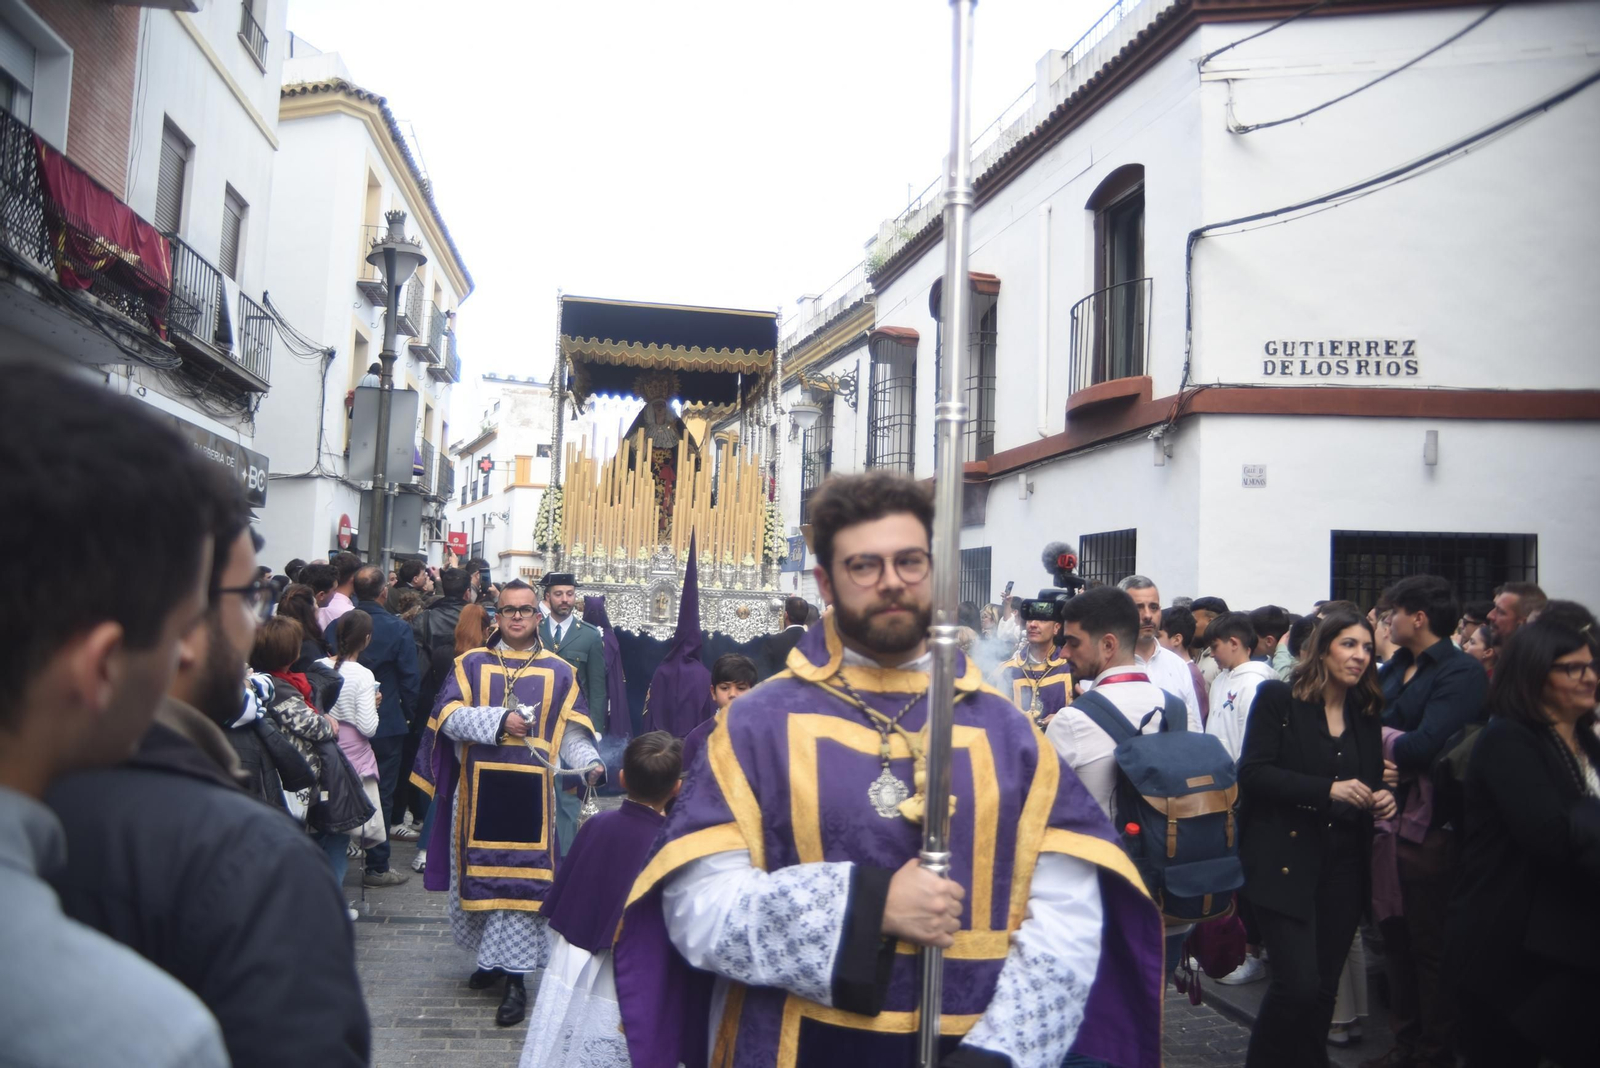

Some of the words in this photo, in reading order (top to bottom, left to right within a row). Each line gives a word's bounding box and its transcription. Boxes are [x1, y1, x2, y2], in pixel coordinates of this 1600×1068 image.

[1264, 340, 1416, 357] GUTIERREZ
[1263, 359, 1294, 376] DE
[1299, 359, 1349, 376] LOS
[1355, 359, 1418, 376] RIOS
[226, 455, 236, 468] DE
